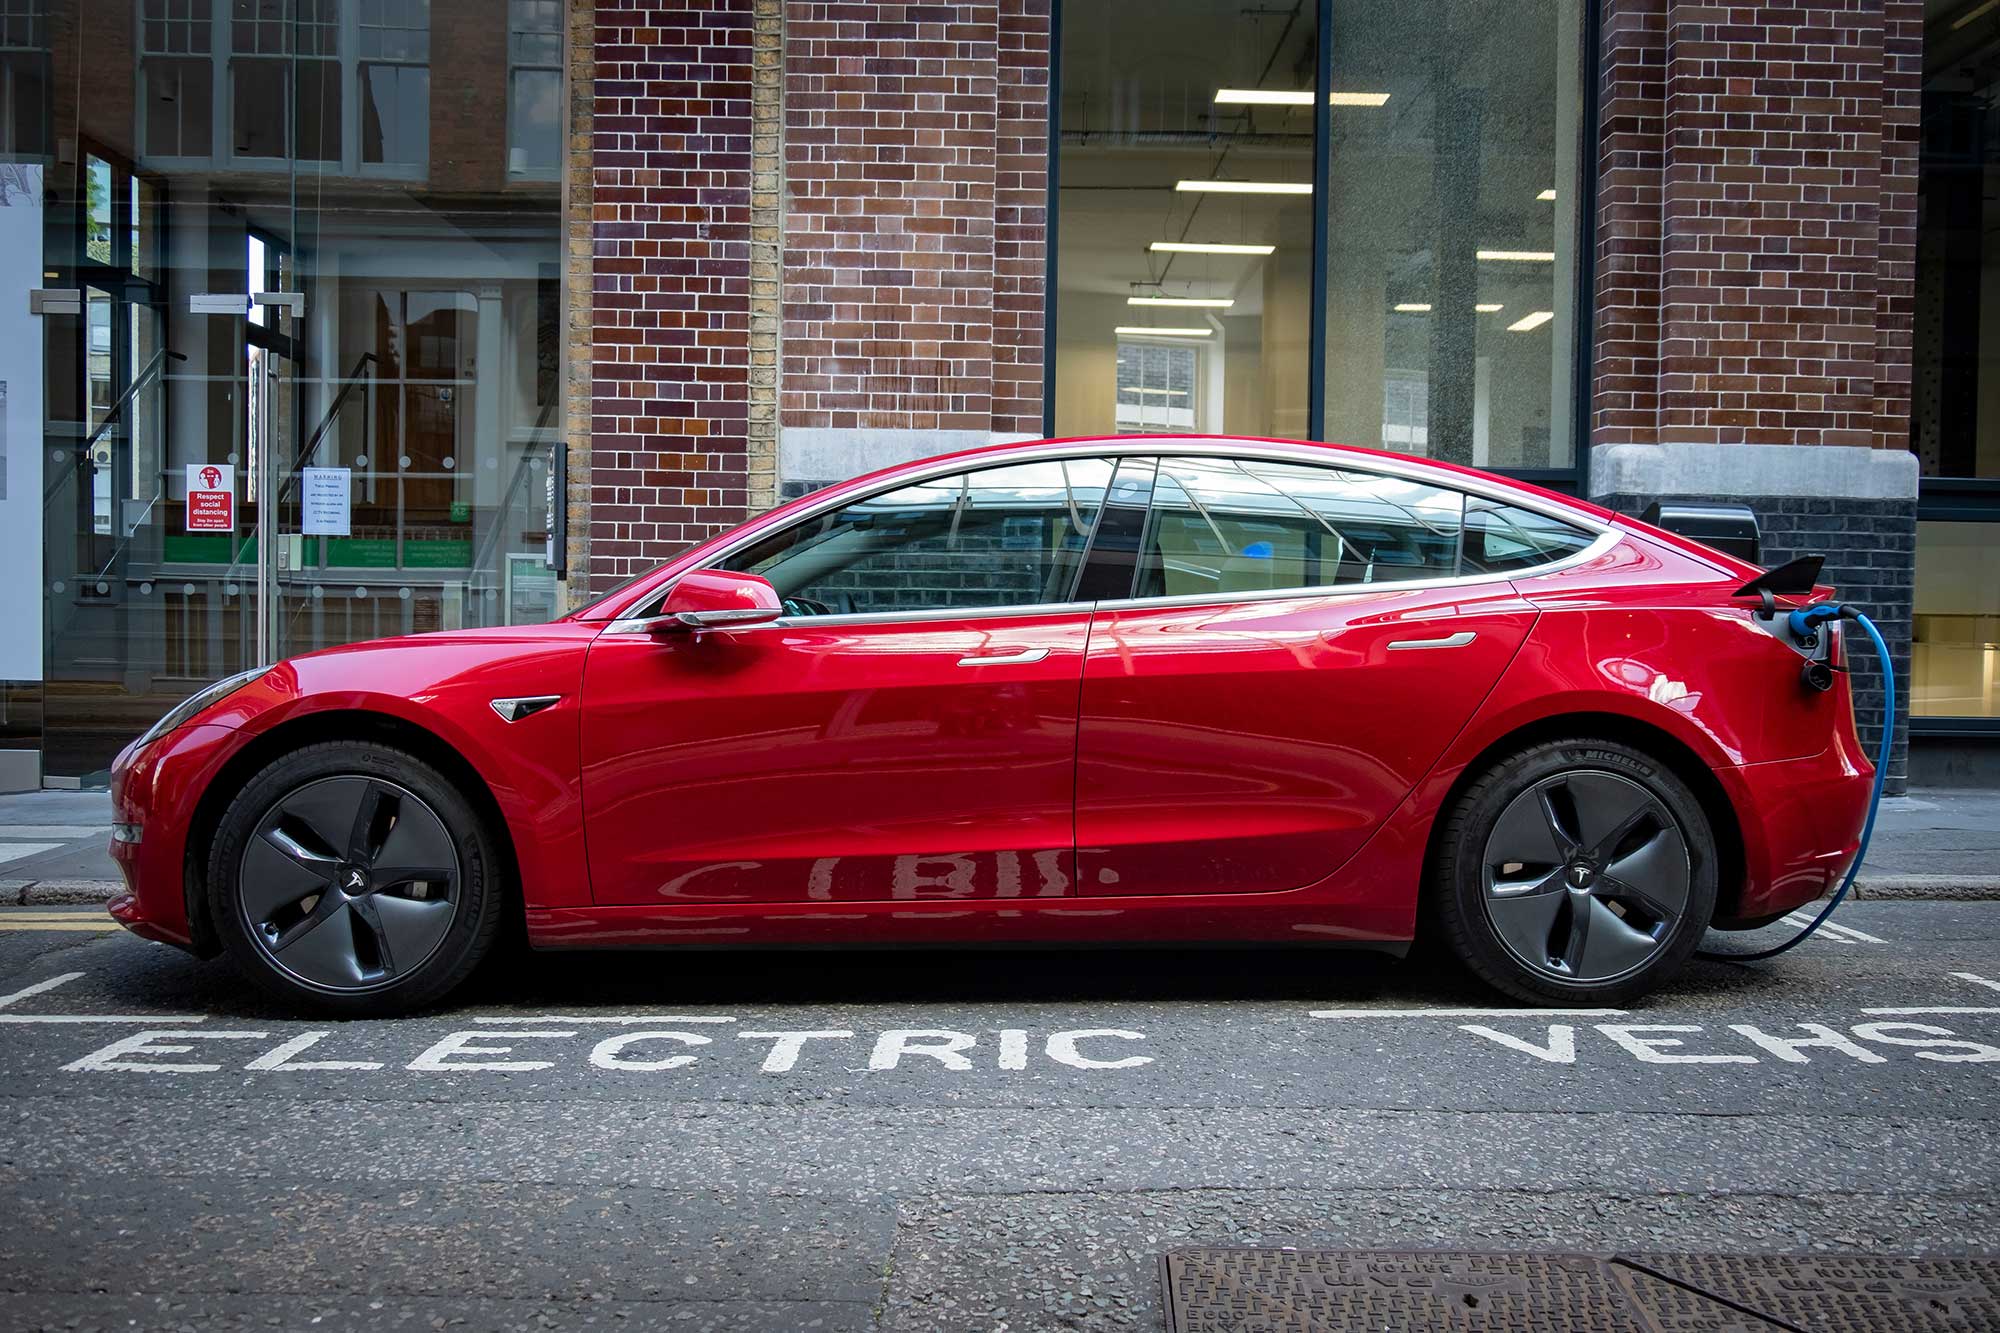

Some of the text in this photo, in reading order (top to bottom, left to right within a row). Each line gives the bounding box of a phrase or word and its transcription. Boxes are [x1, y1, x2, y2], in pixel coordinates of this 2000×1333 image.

[197, 493, 224, 501] Respect
[1585, 750, 1652, 775] MICHELIN
[58, 1022, 2000, 1072] ELECTRIC VEHS
